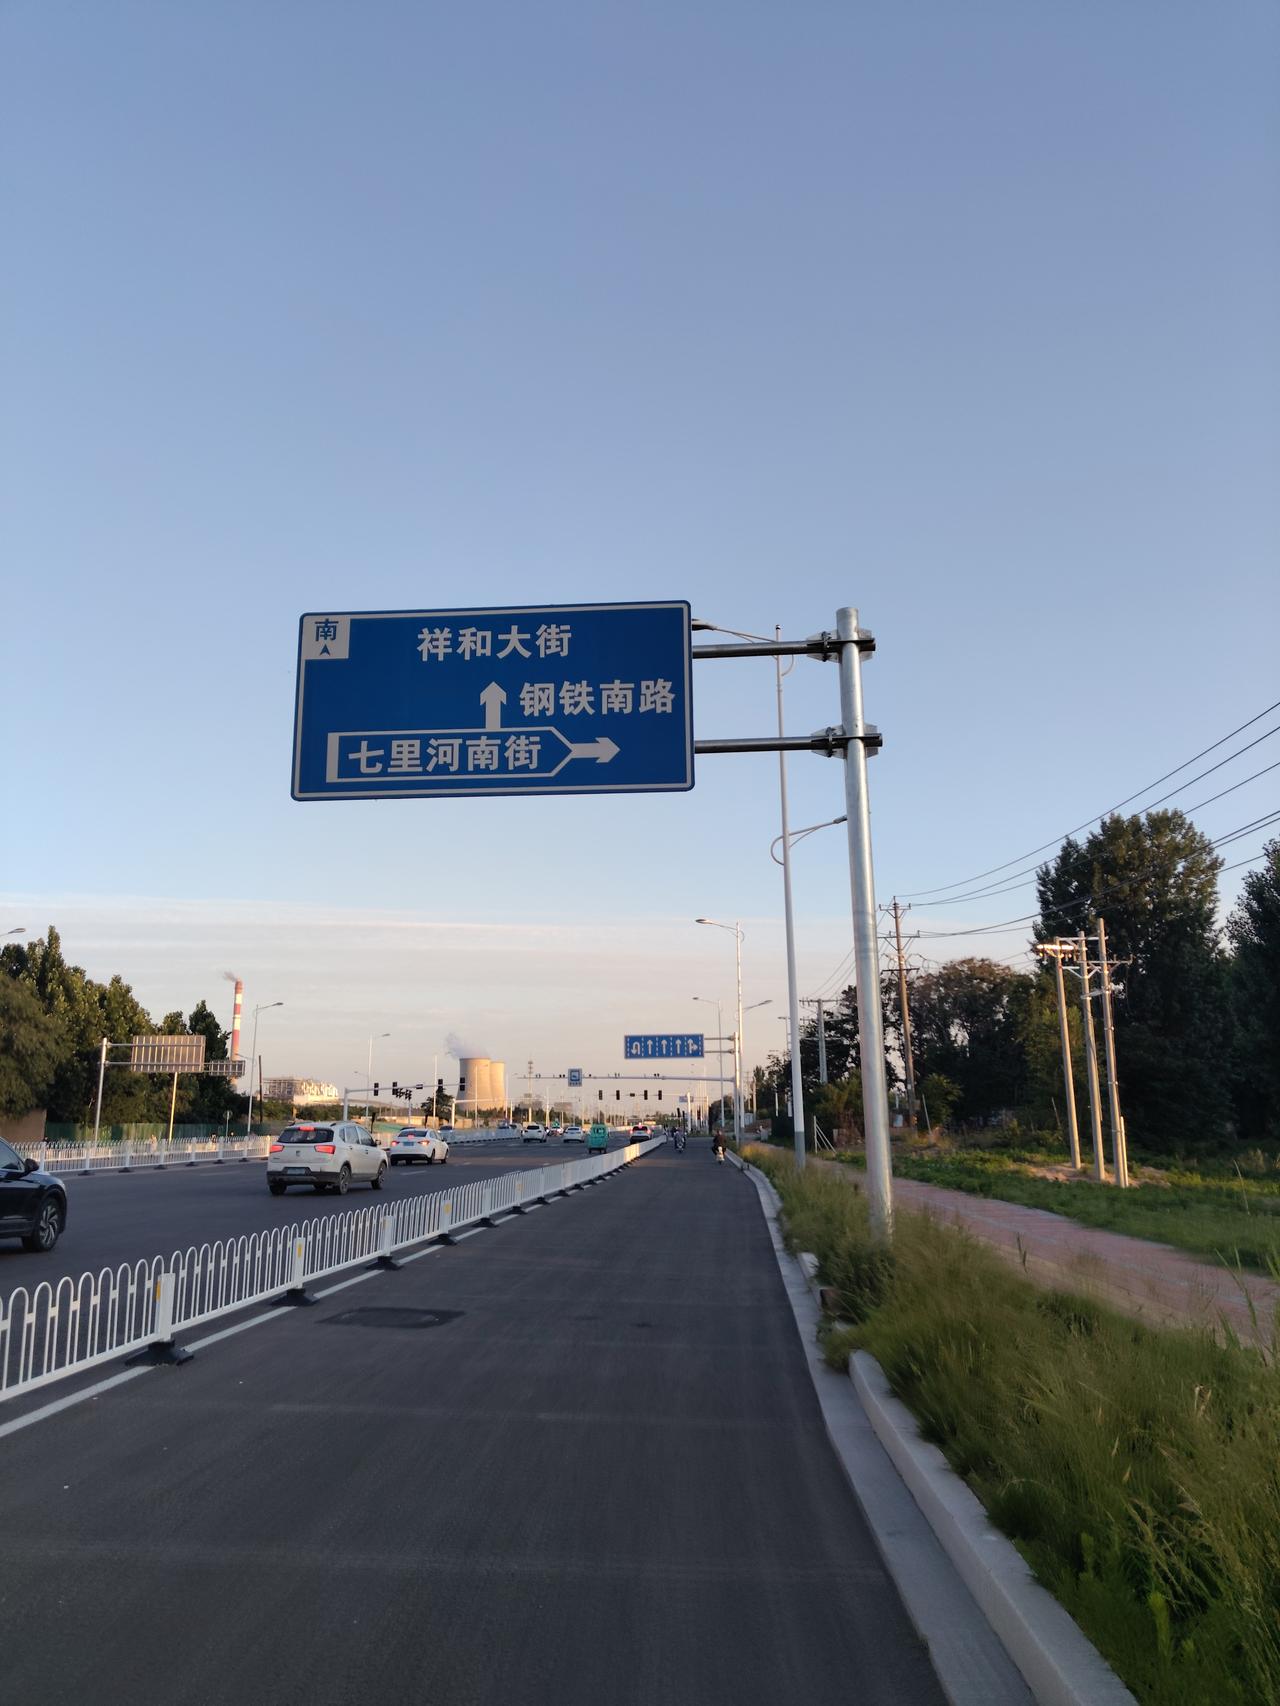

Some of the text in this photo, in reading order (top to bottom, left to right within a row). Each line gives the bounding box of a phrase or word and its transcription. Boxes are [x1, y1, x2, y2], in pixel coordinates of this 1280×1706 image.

[315, 618, 339, 642] 南
[417, 623, 573, 662] 祥和大街
[519, 678, 676, 717] 钢铁南路
[348, 734, 542, 774] 七里河南街
